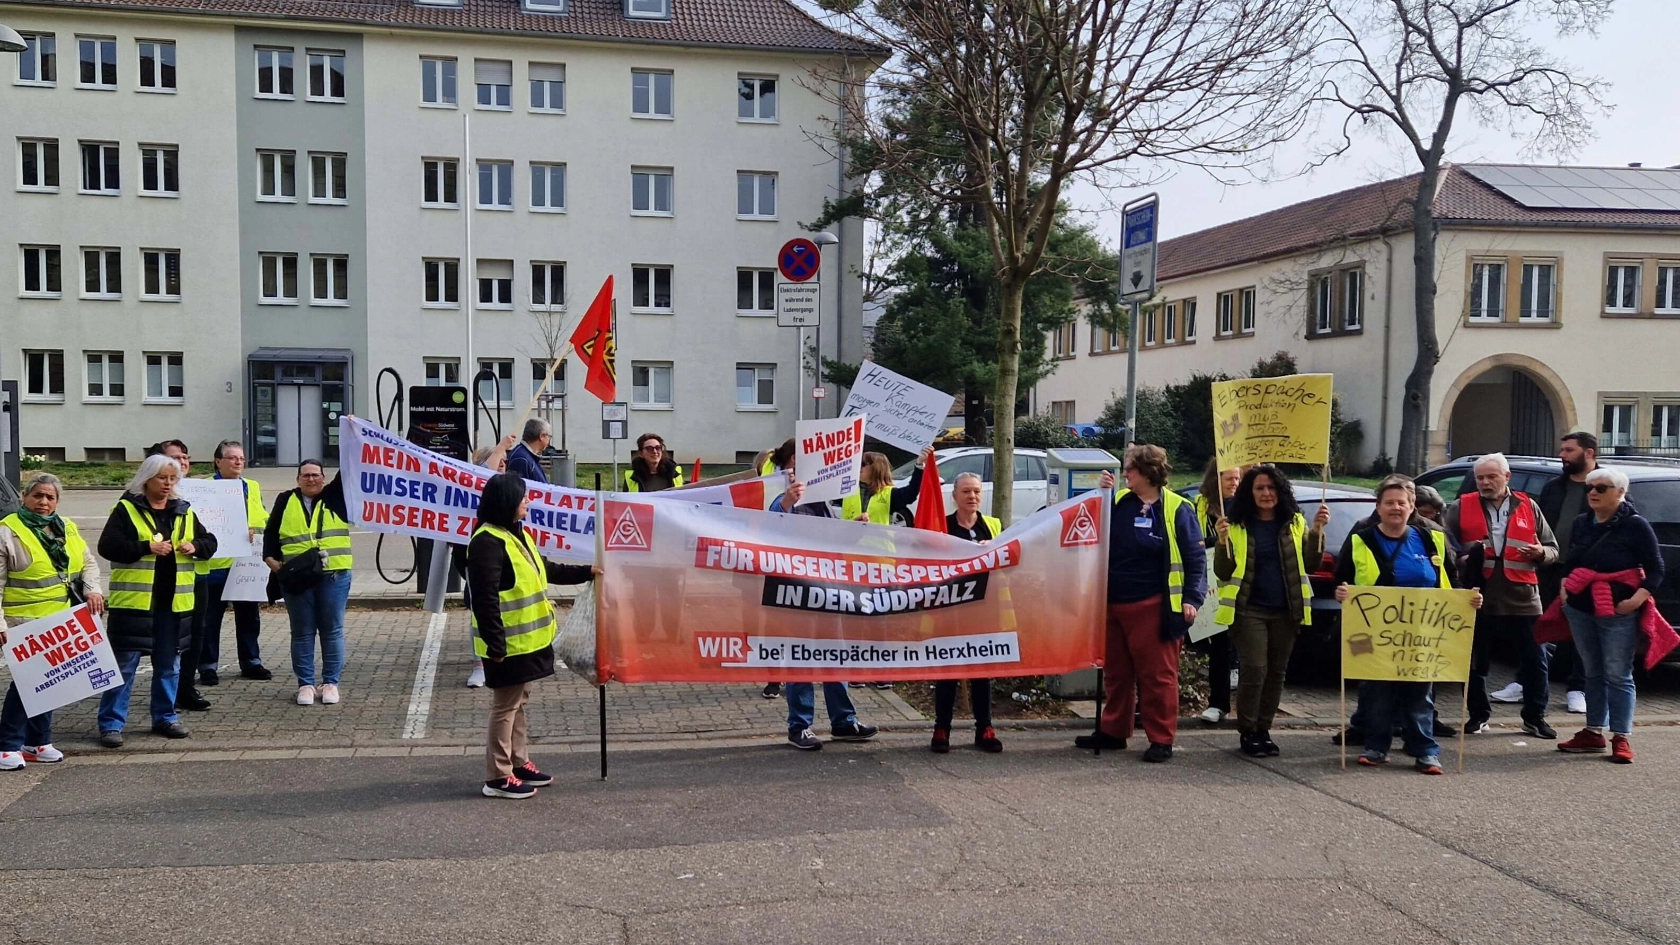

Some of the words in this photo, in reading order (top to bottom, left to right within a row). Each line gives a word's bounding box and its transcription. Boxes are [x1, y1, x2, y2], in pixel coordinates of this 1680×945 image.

[226, 381, 233, 393] 3
[862, 367, 915, 396] HEUTE
[803, 427, 852, 454] HÄNDE
[361, 443, 420, 473] MEIN
[817, 467, 829, 475] VON
[830, 459, 852, 471] UNSEREN
[361, 471, 437, 504] UNSER
[362, 501, 449, 533] UNSERE
[706, 541, 755, 571] FÜR
[759, 551, 848, 581] UNSERE
[852, 546, 1011, 584] PERSPEKTIVE
[775, 584, 802, 607] IN
[807, 586, 857, 612] DER
[859, 581, 977, 614] SÜDPFALZ
[1351, 592, 1473, 633] Politiker
[12, 618, 82, 662] HÄNDE
[697, 636, 743, 658] WIR
[758, 643, 785, 660] bei
[791, 645, 897, 664] Eberspächer
[904, 645, 919, 660] in
[925, 639, 1011, 660] Herxheim
[44, 667, 60, 678] VON
[61, 650, 95, 671] UNSEREN
[1392, 648, 1447, 663] nicht
[35, 657, 98, 693] ARBEITSPLÄTZEN!
